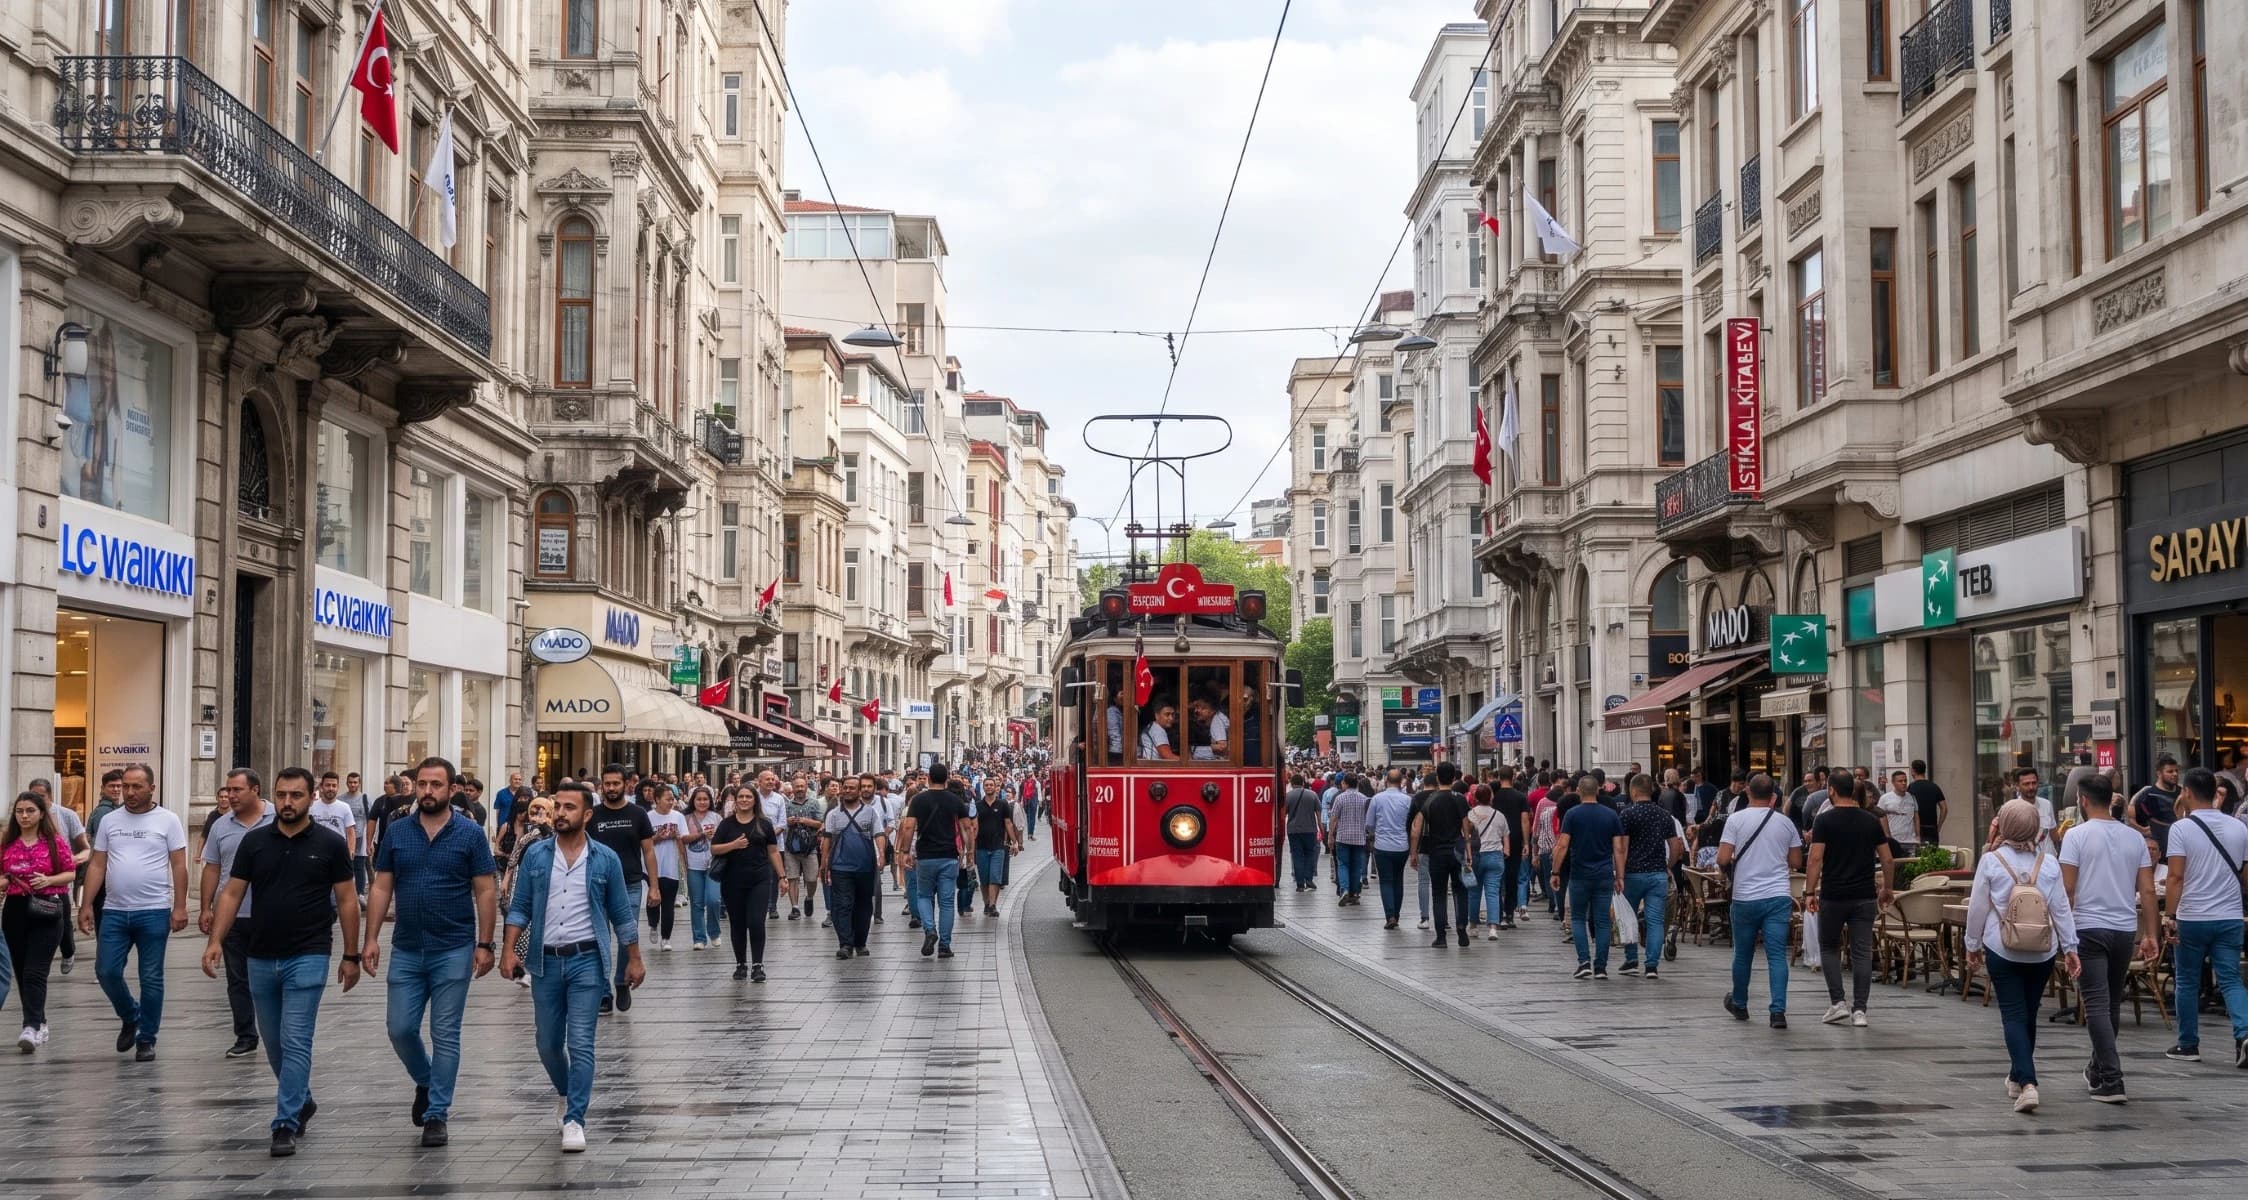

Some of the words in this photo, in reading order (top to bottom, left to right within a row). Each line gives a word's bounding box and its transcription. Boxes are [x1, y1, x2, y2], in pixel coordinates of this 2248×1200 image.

[62, 523, 97, 576] LC
[2149, 515, 2248, 582] SARAY
[1959, 564, 1993, 598] TEB
[540, 637, 583, 649] MADO
[605, 605, 640, 648] MADO
[1709, 604, 1749, 648] MADO
[545, 699, 610, 713] MADO
[1095, 785, 1114, 803] 20
[1254, 786, 1271, 803] 20
